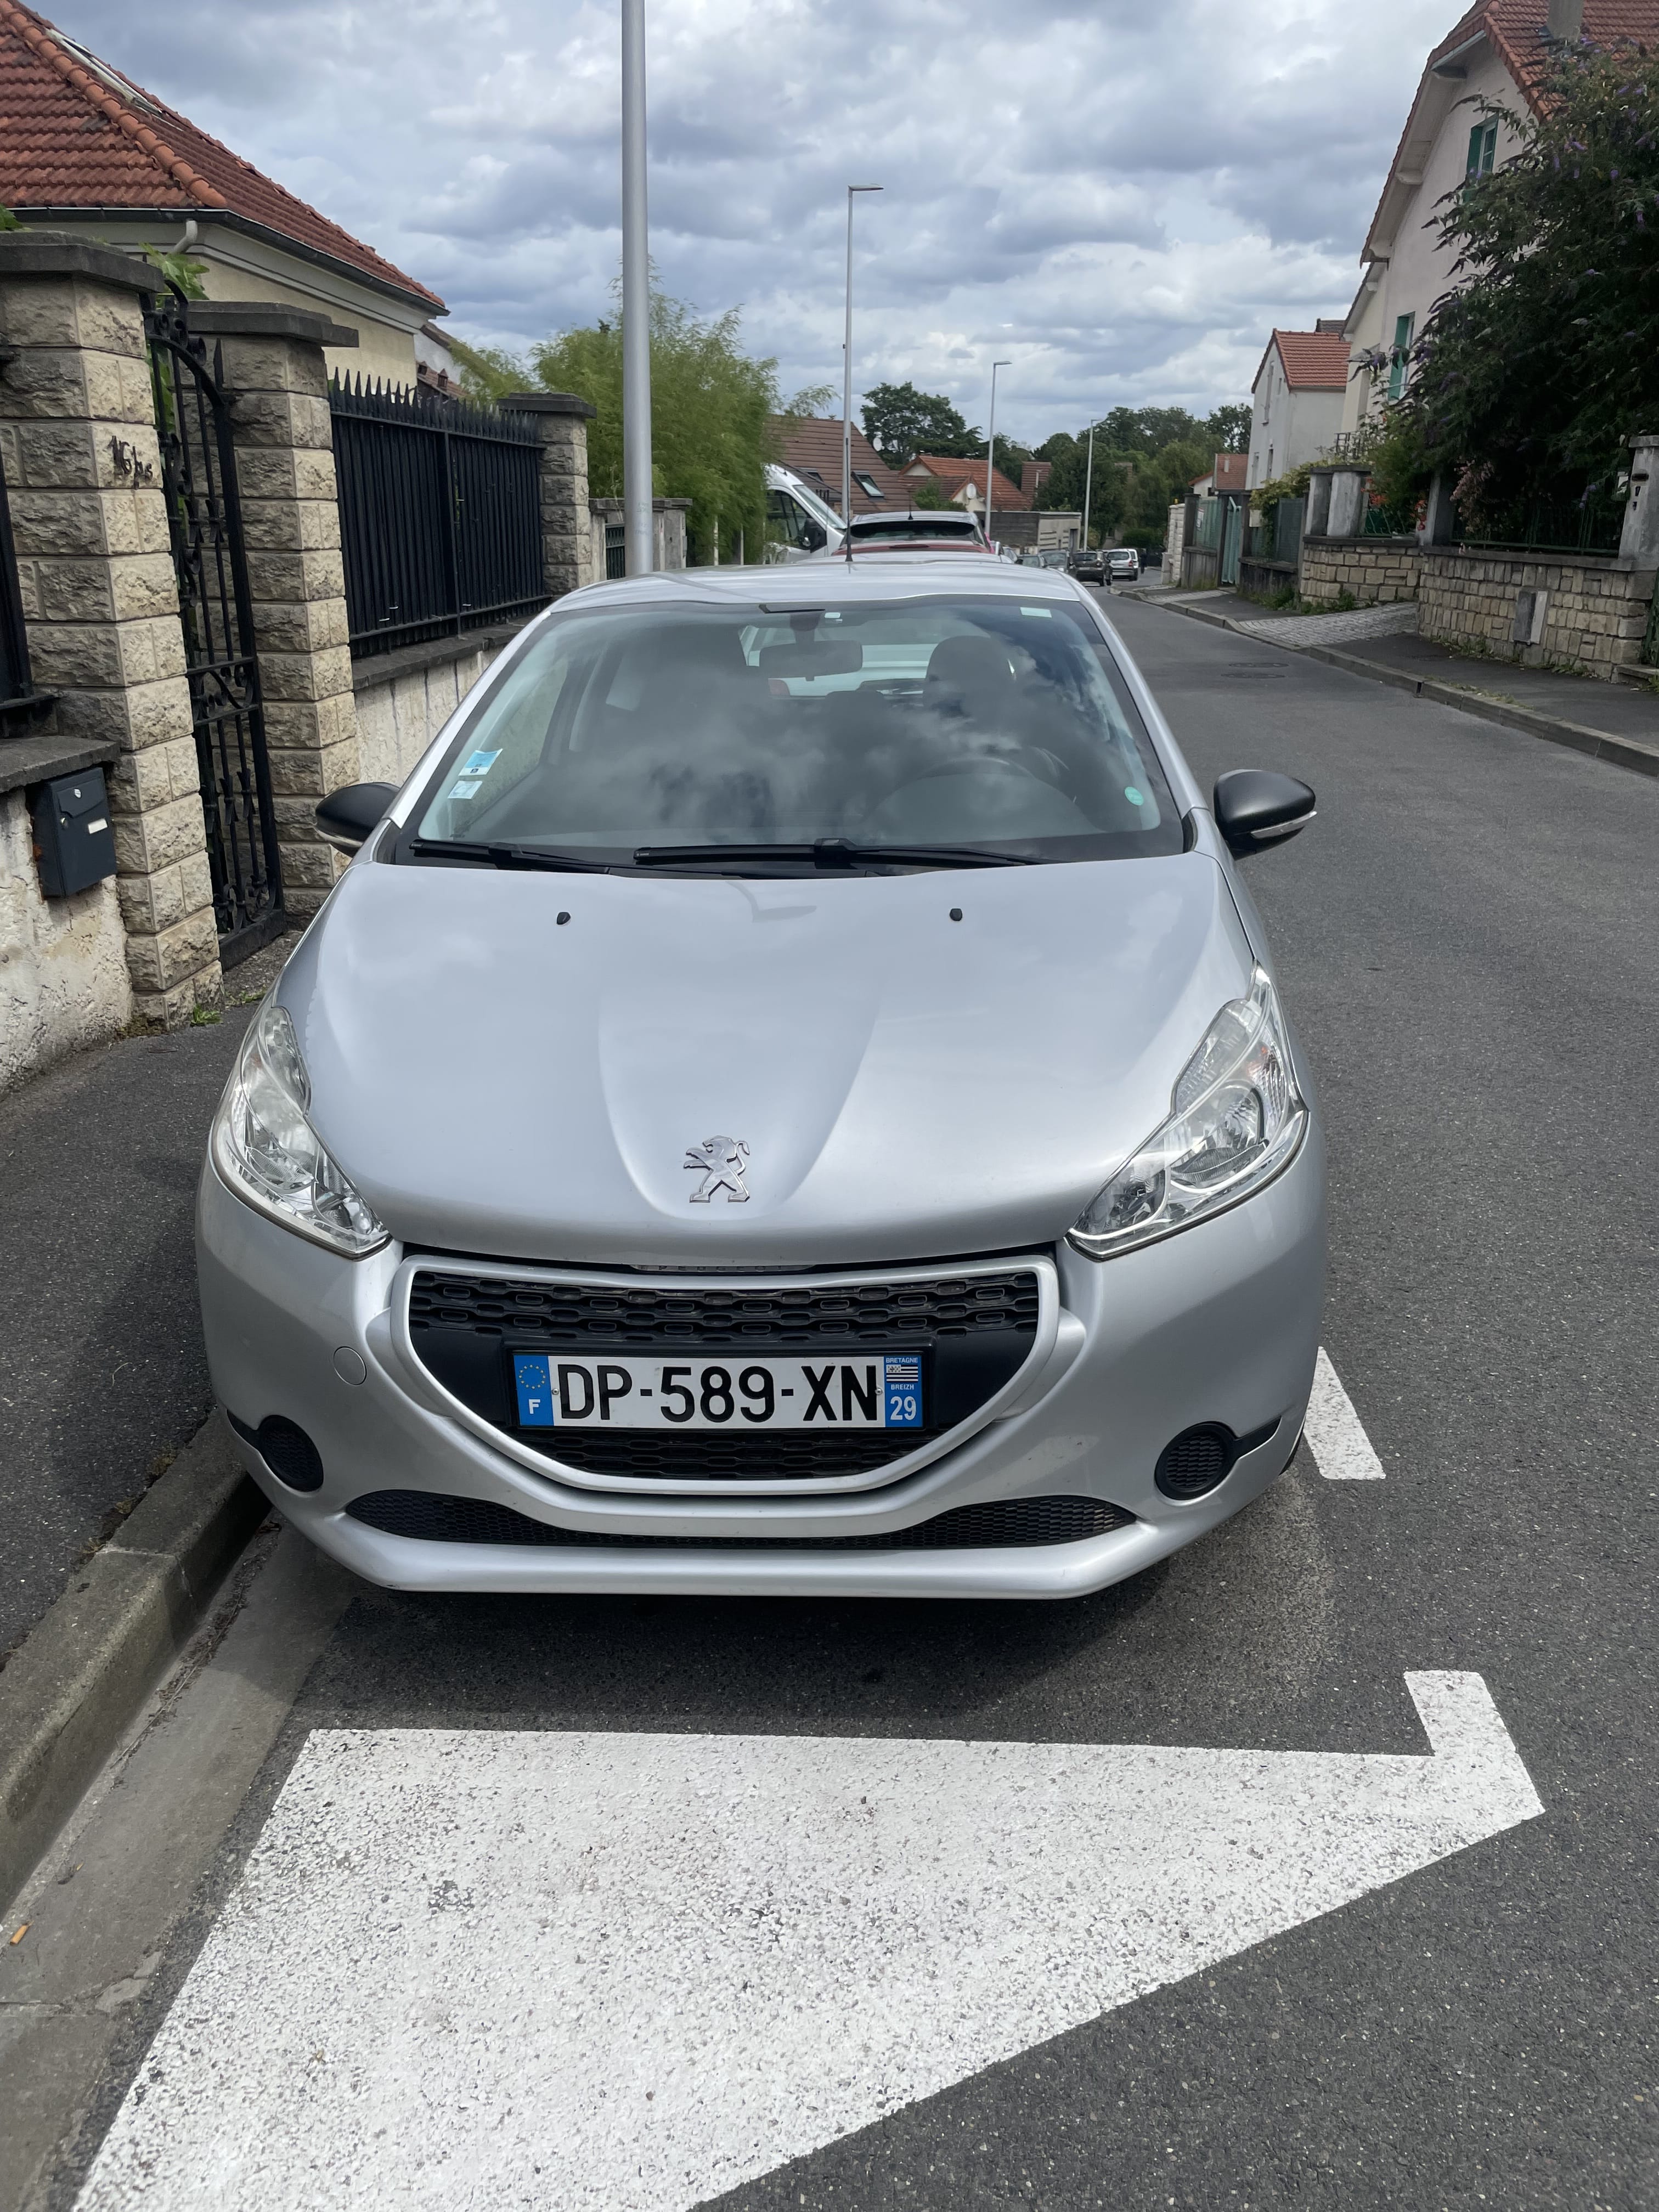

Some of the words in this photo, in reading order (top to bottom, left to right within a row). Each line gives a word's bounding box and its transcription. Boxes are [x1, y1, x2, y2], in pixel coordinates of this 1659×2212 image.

[108, 436, 132, 475] 16
[529, 1399, 541, 1414] F
[557, 1364, 877, 1423] DP-589-XN
[890, 1396, 917, 1420] 29
